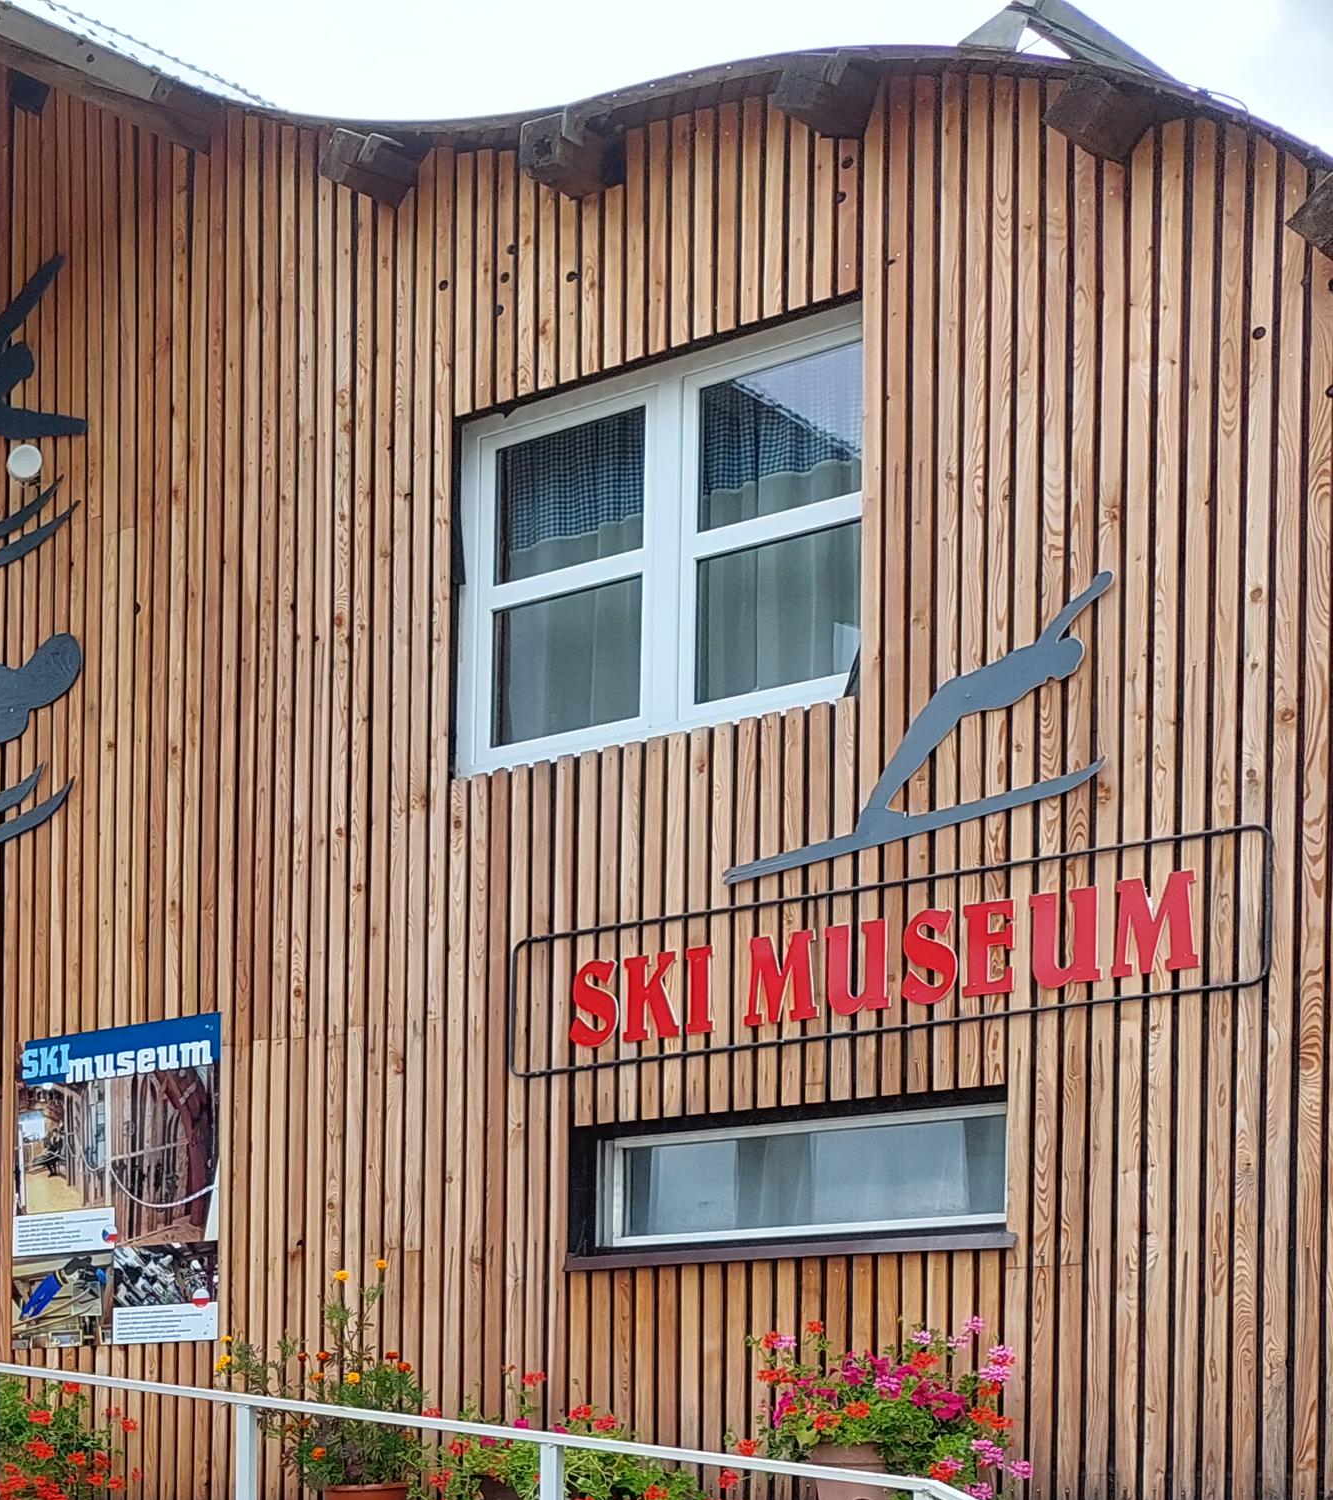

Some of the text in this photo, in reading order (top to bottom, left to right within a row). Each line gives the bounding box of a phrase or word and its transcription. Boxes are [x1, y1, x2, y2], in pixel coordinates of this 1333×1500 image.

[568, 869, 1201, 1048] SKI MUSEUM
[21, 1039, 213, 1084] SKI museum
